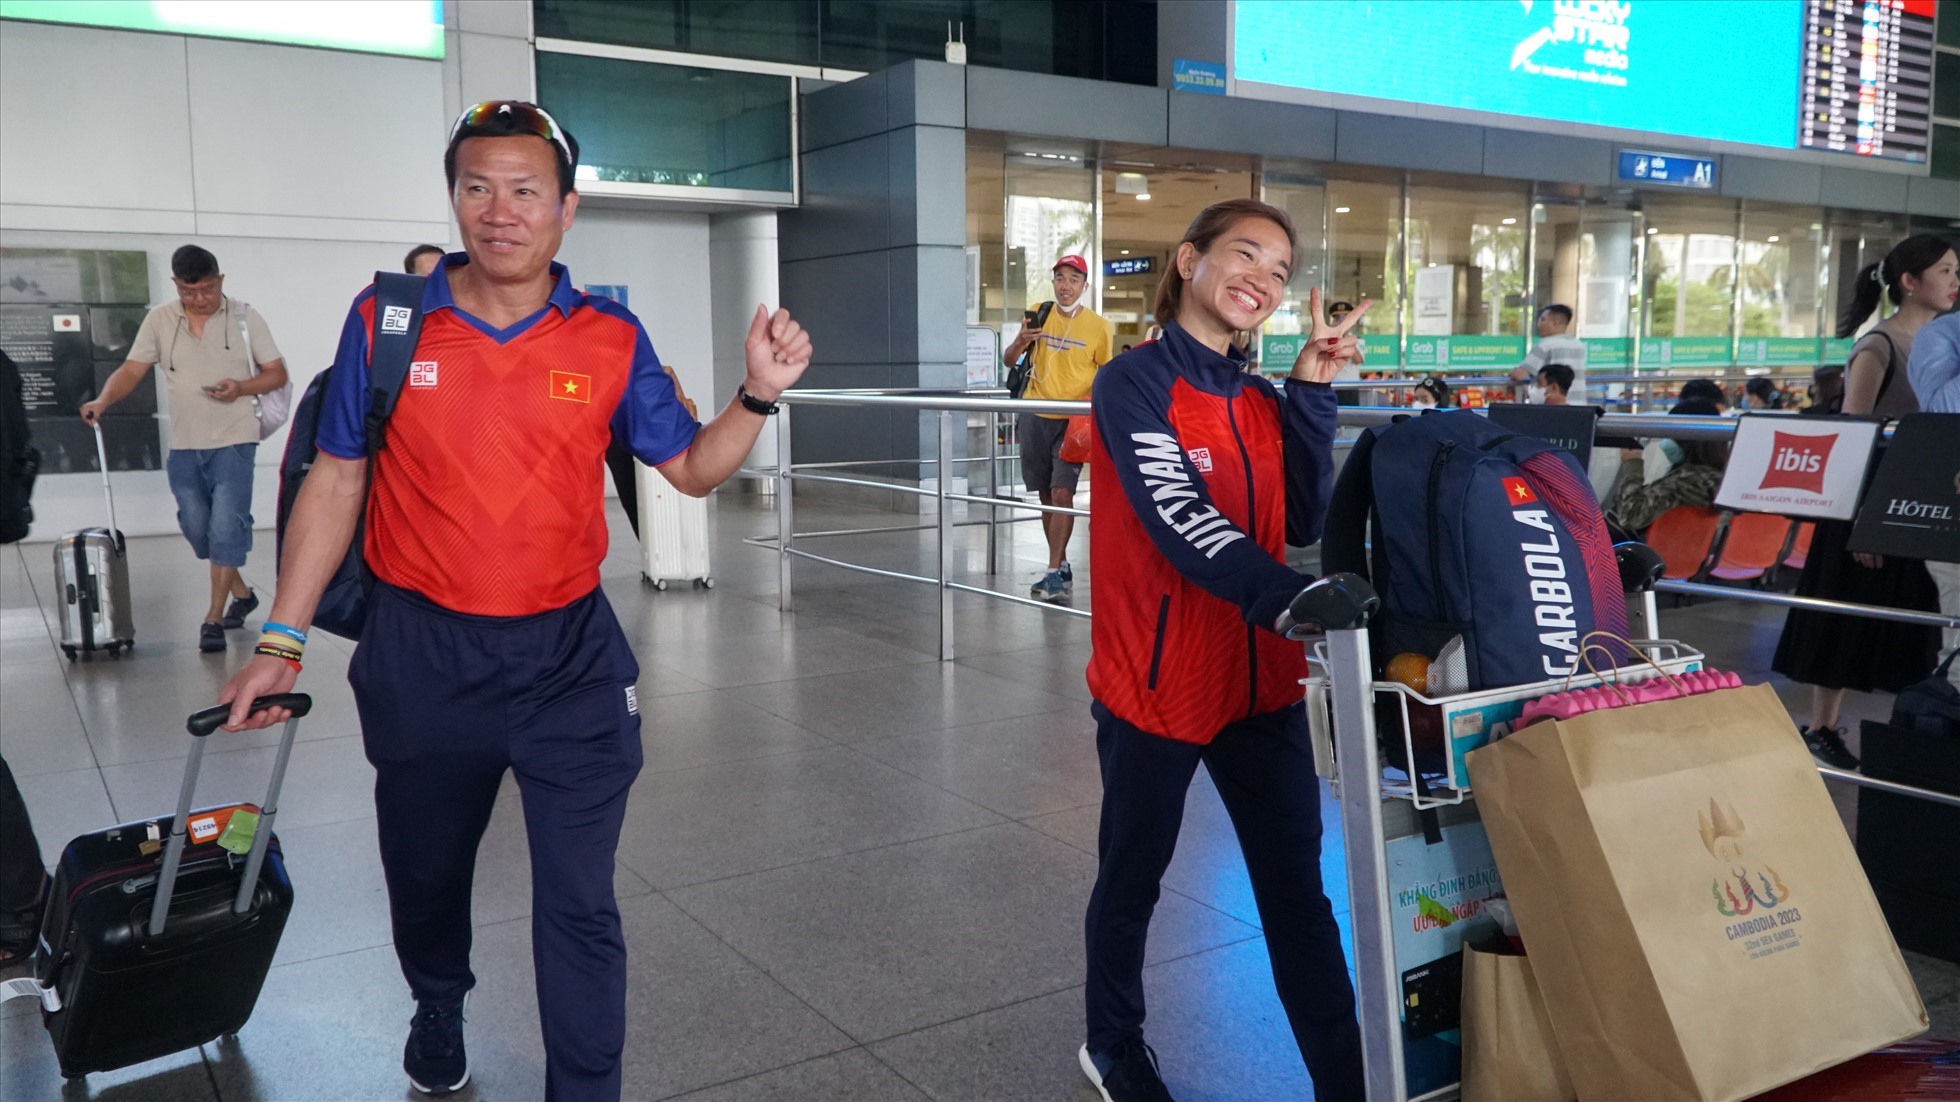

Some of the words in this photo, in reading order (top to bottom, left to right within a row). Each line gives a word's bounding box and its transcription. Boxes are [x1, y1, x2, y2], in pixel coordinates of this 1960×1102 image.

[1693, 161, 1712, 182] A1
[1270, 341, 1294, 354] Grab
[1412, 341, 1434, 354] Grab
[1775, 447, 1822, 473] ibis
[1131, 433, 1246, 560] VIETNAM
[1886, 499, 1953, 520] HÔTEL
[1512, 509, 1579, 678] GARBOLA
[1725, 914, 1778, 941] CAMBODIA
[1777, 907, 1801, 925] 2023
